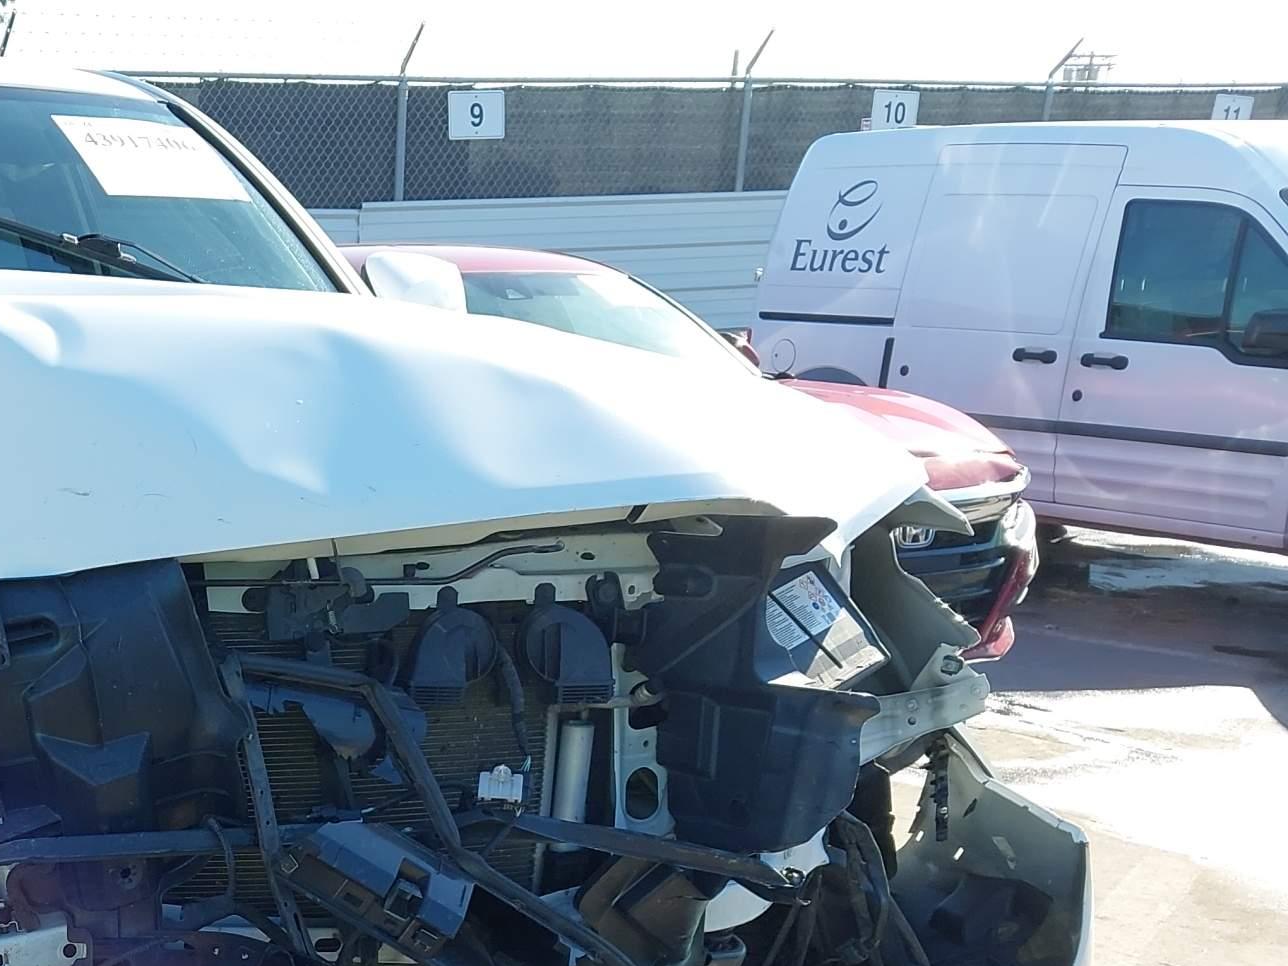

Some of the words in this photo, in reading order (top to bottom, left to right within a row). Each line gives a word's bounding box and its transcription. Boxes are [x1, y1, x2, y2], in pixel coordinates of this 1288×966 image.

[470, 102, 484, 127] 9
[884, 101, 906, 124] 10
[790, 239, 890, 274] Eurest
